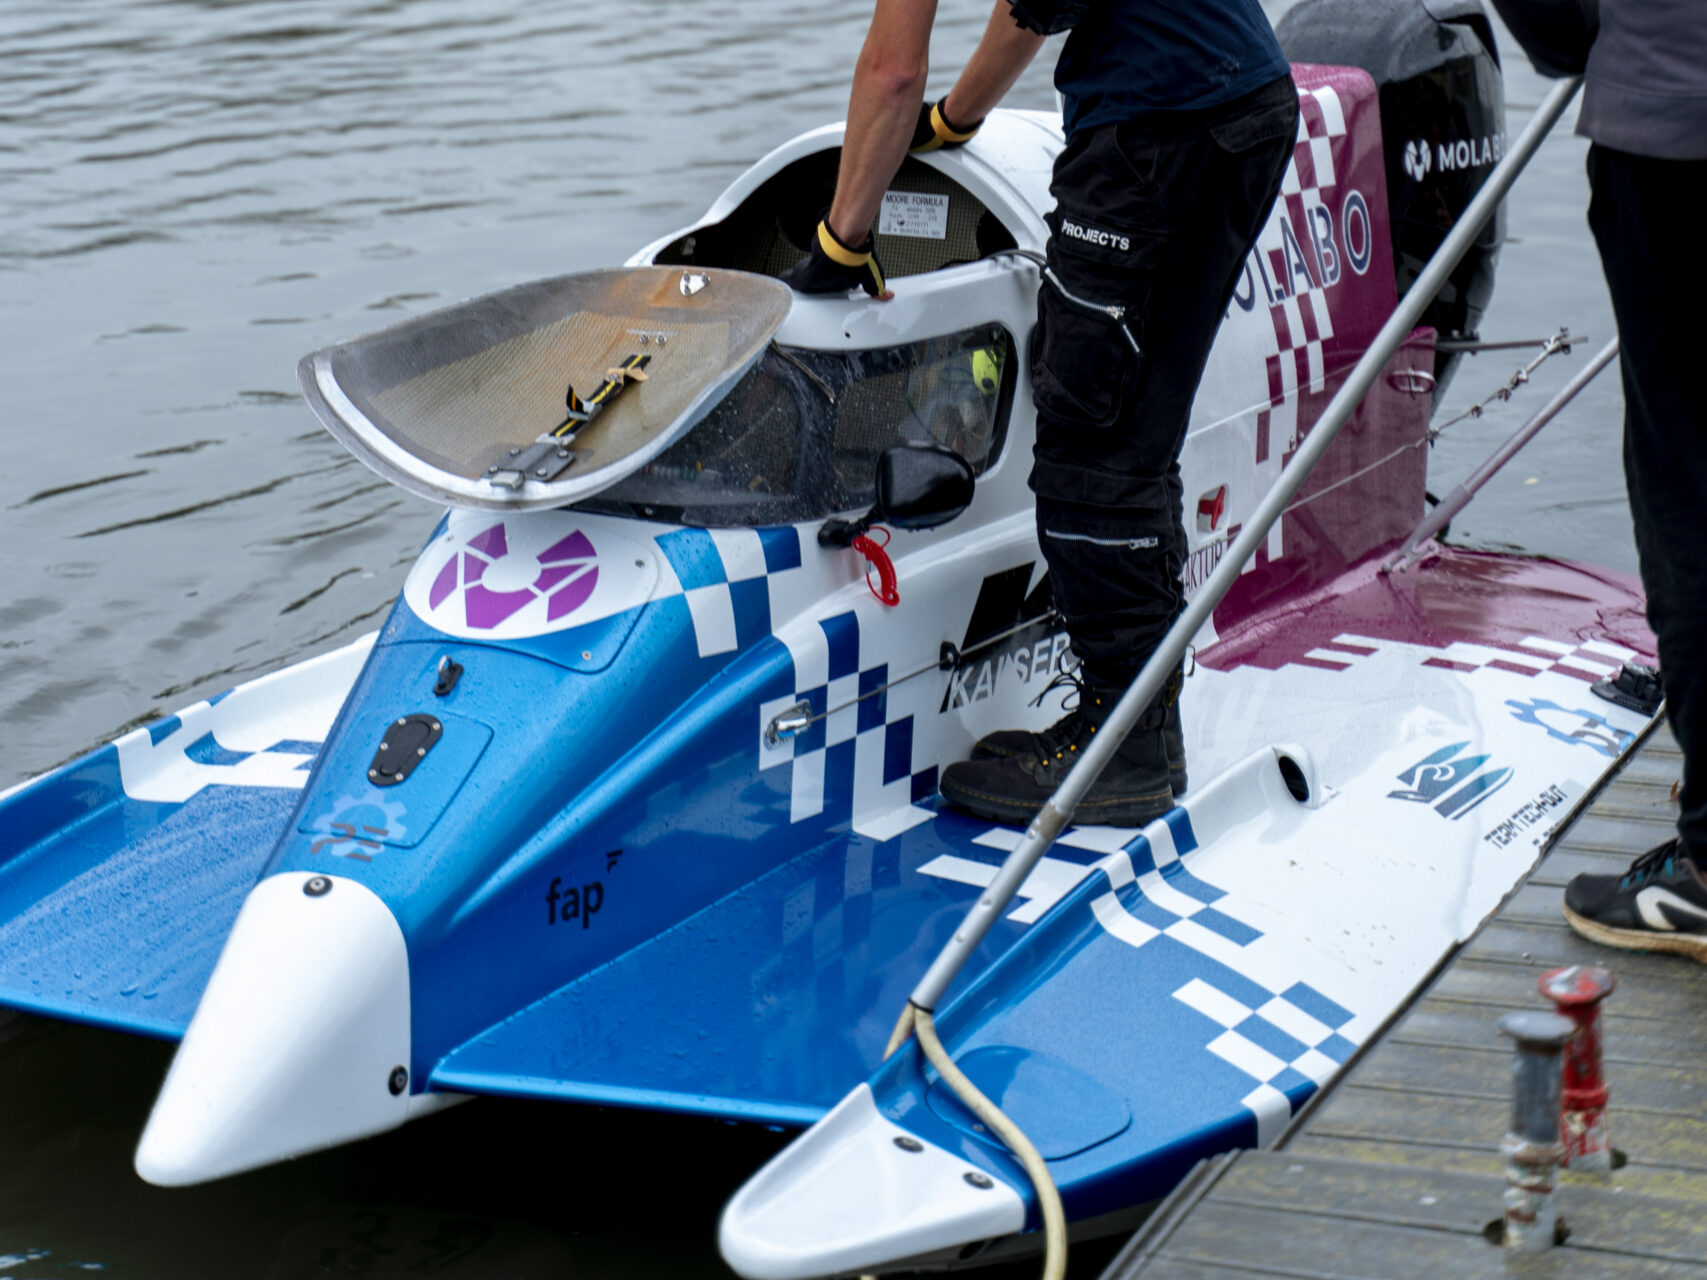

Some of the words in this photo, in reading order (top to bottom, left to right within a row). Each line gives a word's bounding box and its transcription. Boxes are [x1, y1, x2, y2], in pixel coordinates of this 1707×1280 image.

[912, 197, 944, 207] FORMULA
[1061, 219, 1130, 251] PROJECTS
[545, 876, 604, 930] fap
